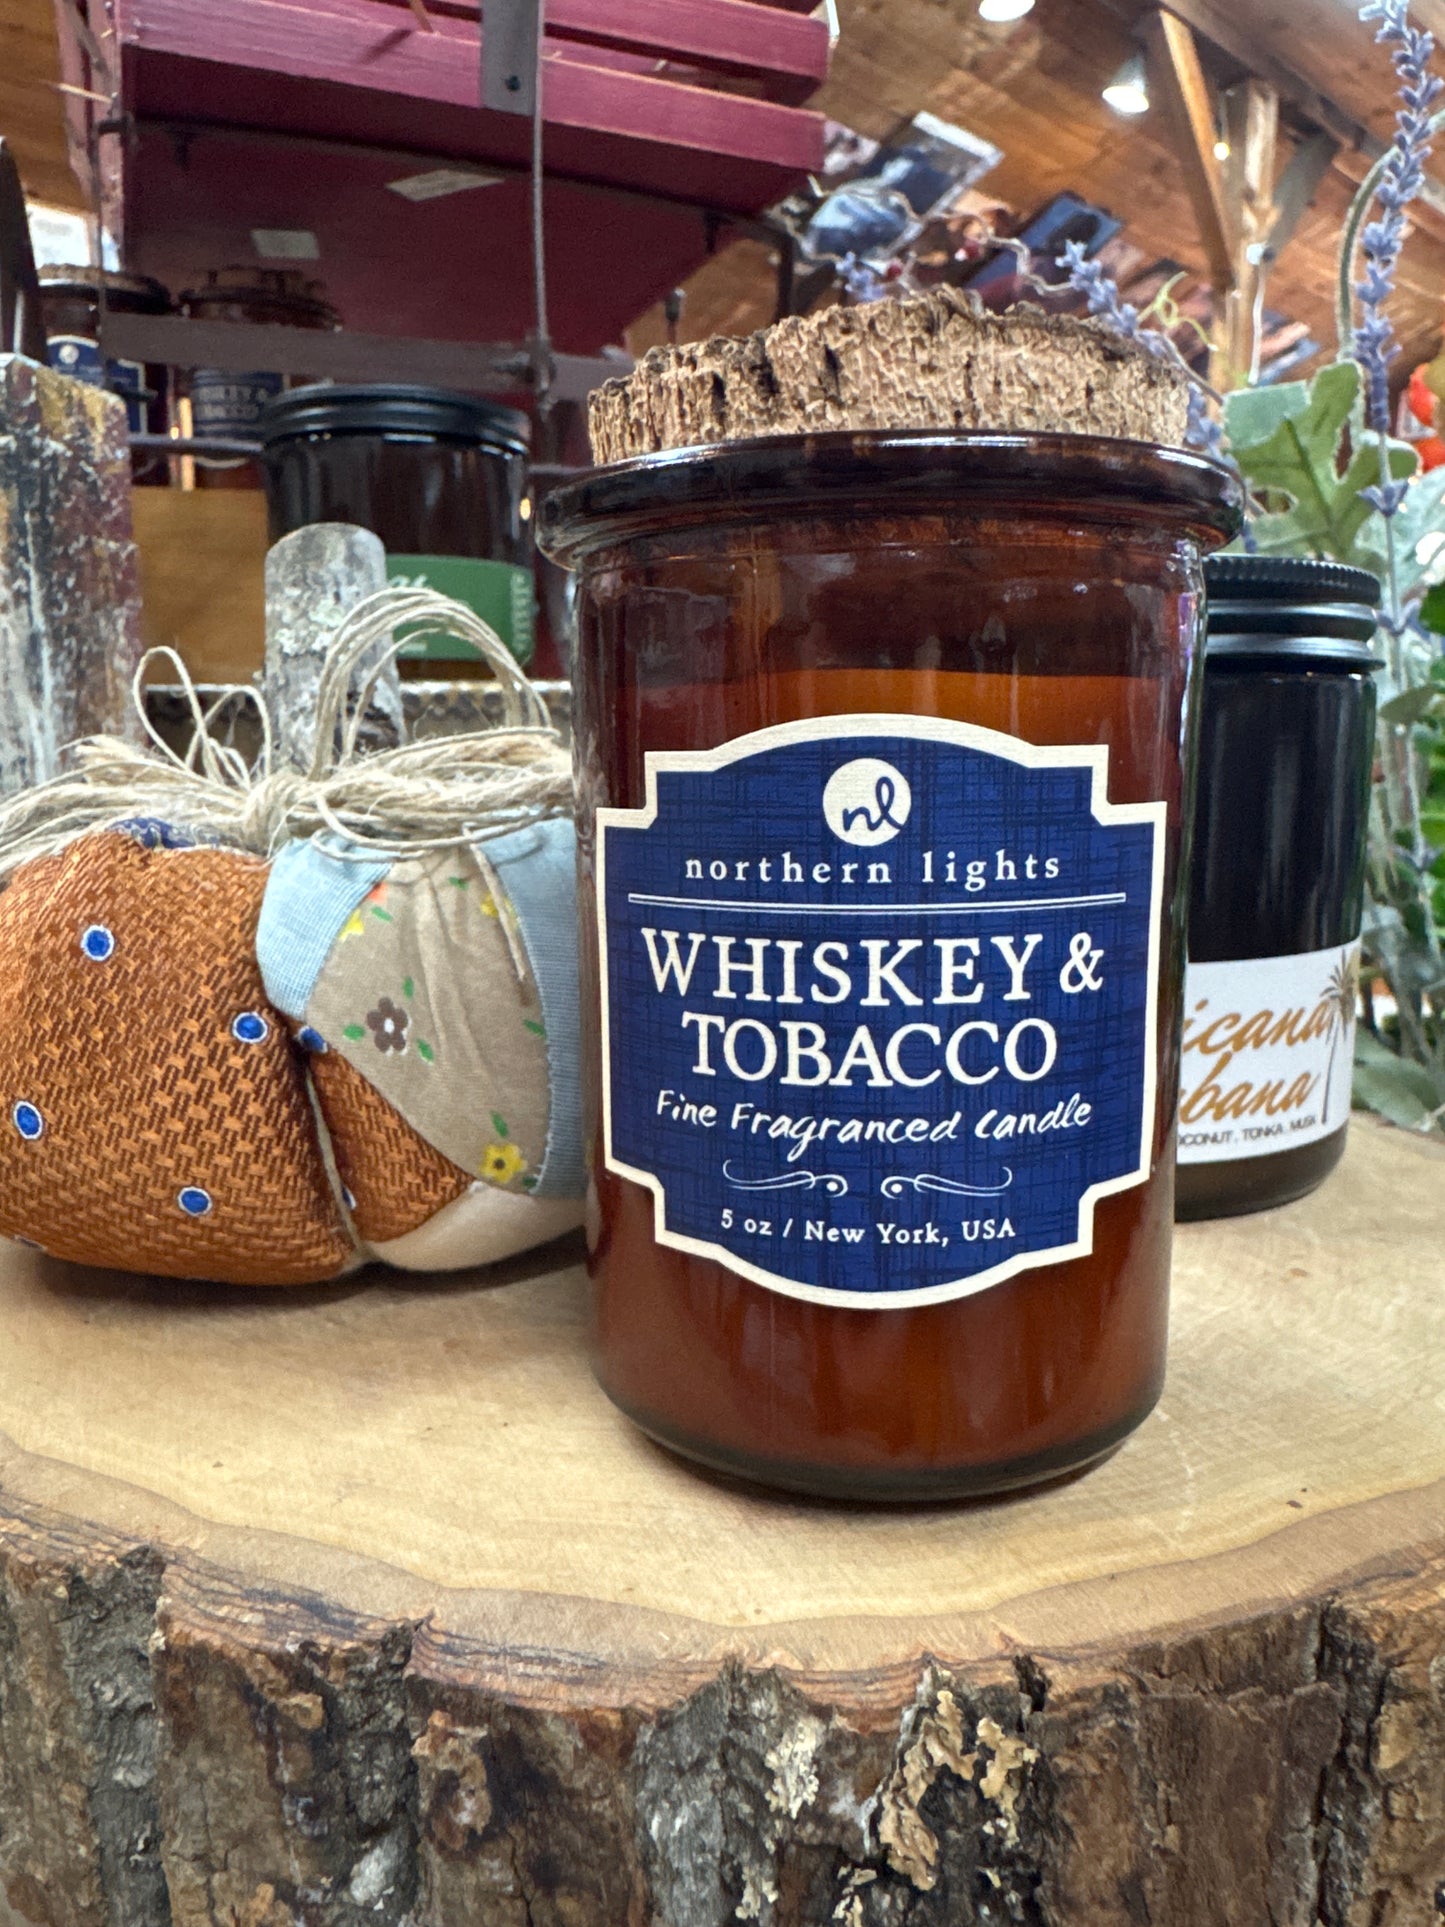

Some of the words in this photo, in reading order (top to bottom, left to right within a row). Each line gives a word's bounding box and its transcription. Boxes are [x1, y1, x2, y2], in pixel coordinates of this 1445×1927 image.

[686, 851, 892, 883] northern
[922, 849, 1060, 892] lights
[640, 927, 1043, 1007] WHISKEY
[1059, 931, 1105, 994] &
[682, 1011, 1058, 1088] TOBACCO
[1179, 1051, 1321, 1124] bana
[656, 1089, 717, 1128] Fine
[730, 1102, 958, 1163] Fragranced
[974, 1092, 1092, 1140] Candle
[720, 1208, 733, 1229] 5
[744, 1218, 773, 1236] oz
[782, 1218, 794, 1238] /
[804, 1219, 866, 1243] New
[876, 1222, 950, 1248] York,
[961, 1217, 1016, 1242] USA
